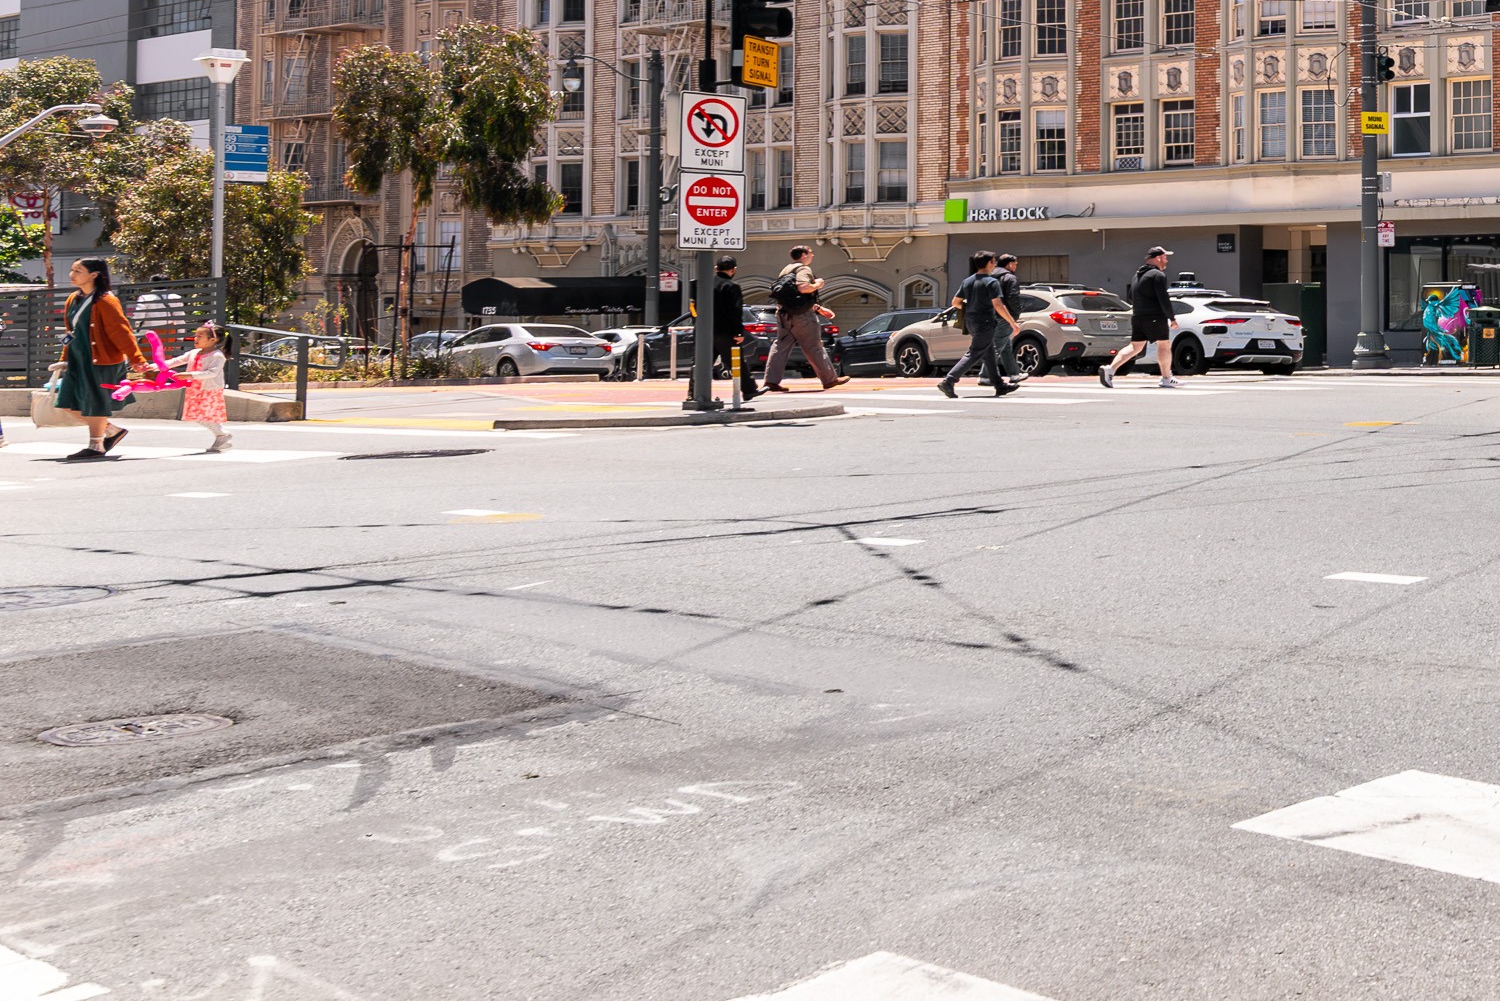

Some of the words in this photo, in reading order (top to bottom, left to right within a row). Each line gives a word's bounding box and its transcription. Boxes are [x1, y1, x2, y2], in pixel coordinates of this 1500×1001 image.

[748, 41, 775, 57] TRANSIT
[752, 55, 770, 68] TURN
[748, 68, 773, 83] SIGNAL
[1365, 122, 1386, 130] SIGNAL
[694, 148, 731, 158] EXCEPT
[700, 158, 724, 167] MUNI
[693, 185, 708, 194] DO
[712, 187, 732, 196] NOT
[696, 208, 728, 217] ENTER
[969, 208, 998, 222] H&R
[1001, 206, 1045, 220] BLOCK
[694, 227, 731, 236] EXCEPT
[683, 236, 707, 245] MUNI
[711, 238, 719, 246] &
[723, 238, 741, 246] GGT
